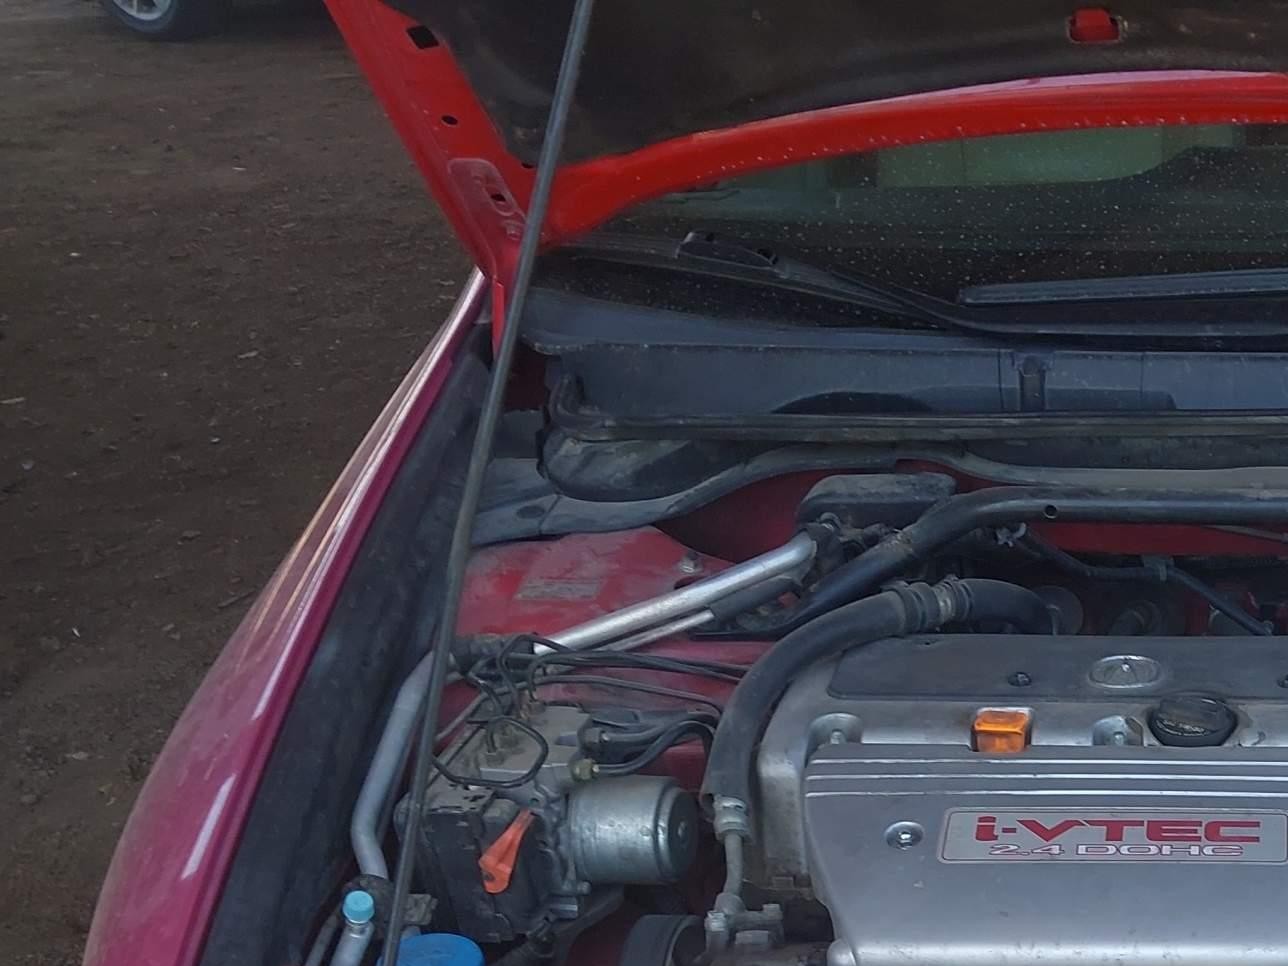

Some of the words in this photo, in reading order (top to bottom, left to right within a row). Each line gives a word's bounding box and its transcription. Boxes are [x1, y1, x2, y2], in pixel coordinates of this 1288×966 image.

[975, 815, 1261, 843] i-VTEC
[988, 844, 1065, 856] 2.4
[1075, 844, 1245, 857] DOHC
